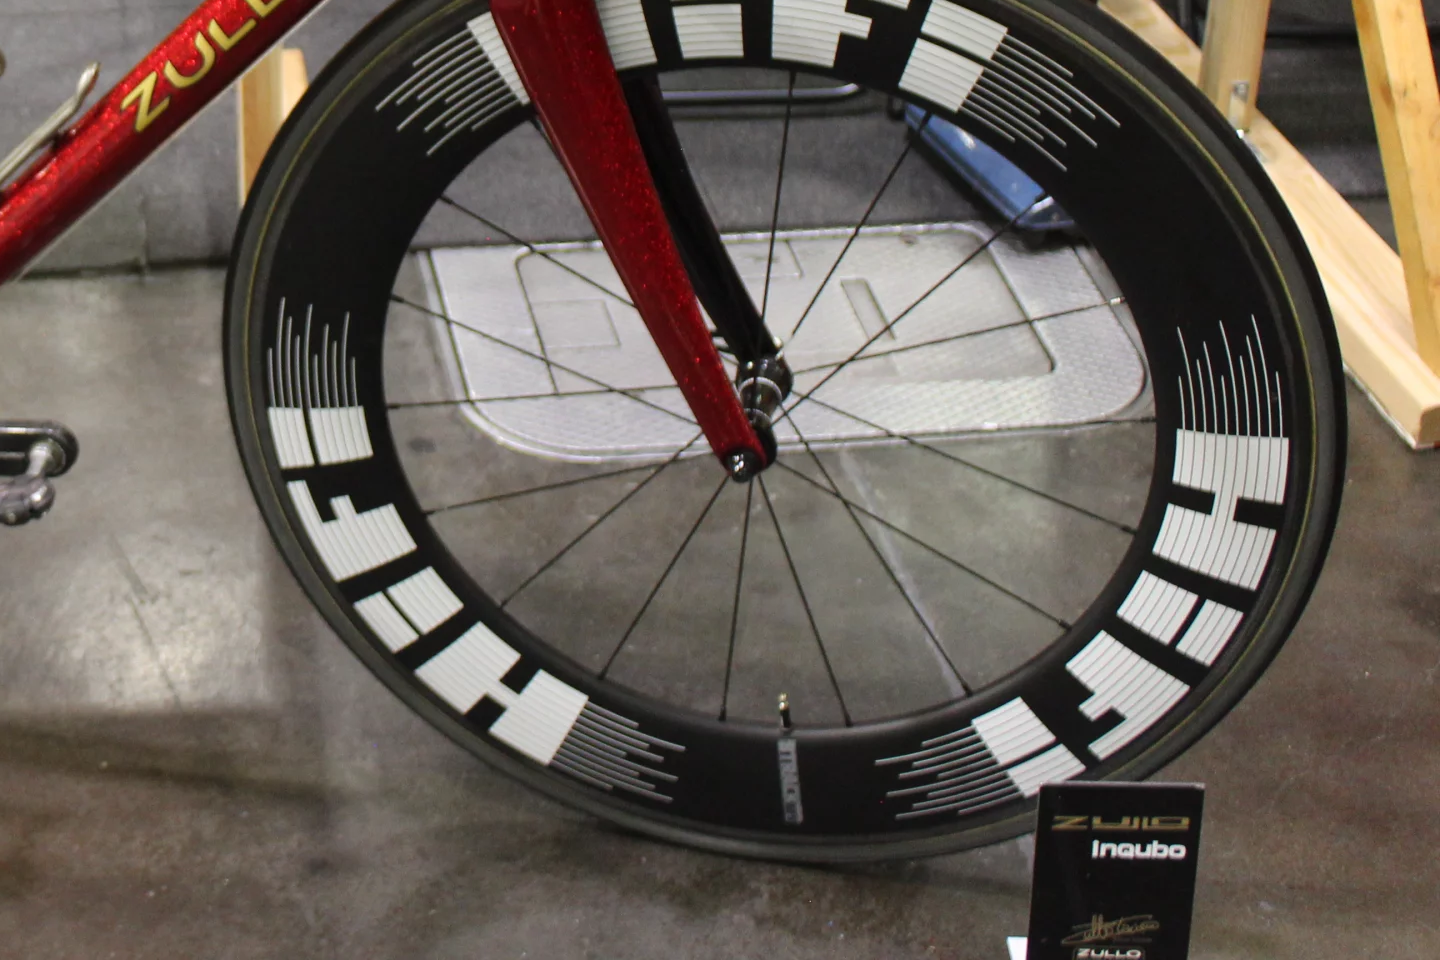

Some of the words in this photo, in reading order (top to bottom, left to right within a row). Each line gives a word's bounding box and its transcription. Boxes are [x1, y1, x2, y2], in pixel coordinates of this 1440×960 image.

[267, 405, 590, 767] HiFi
[970, 428, 1291, 799] HiFi
[1076, 948, 1142, 958] ZULLO
